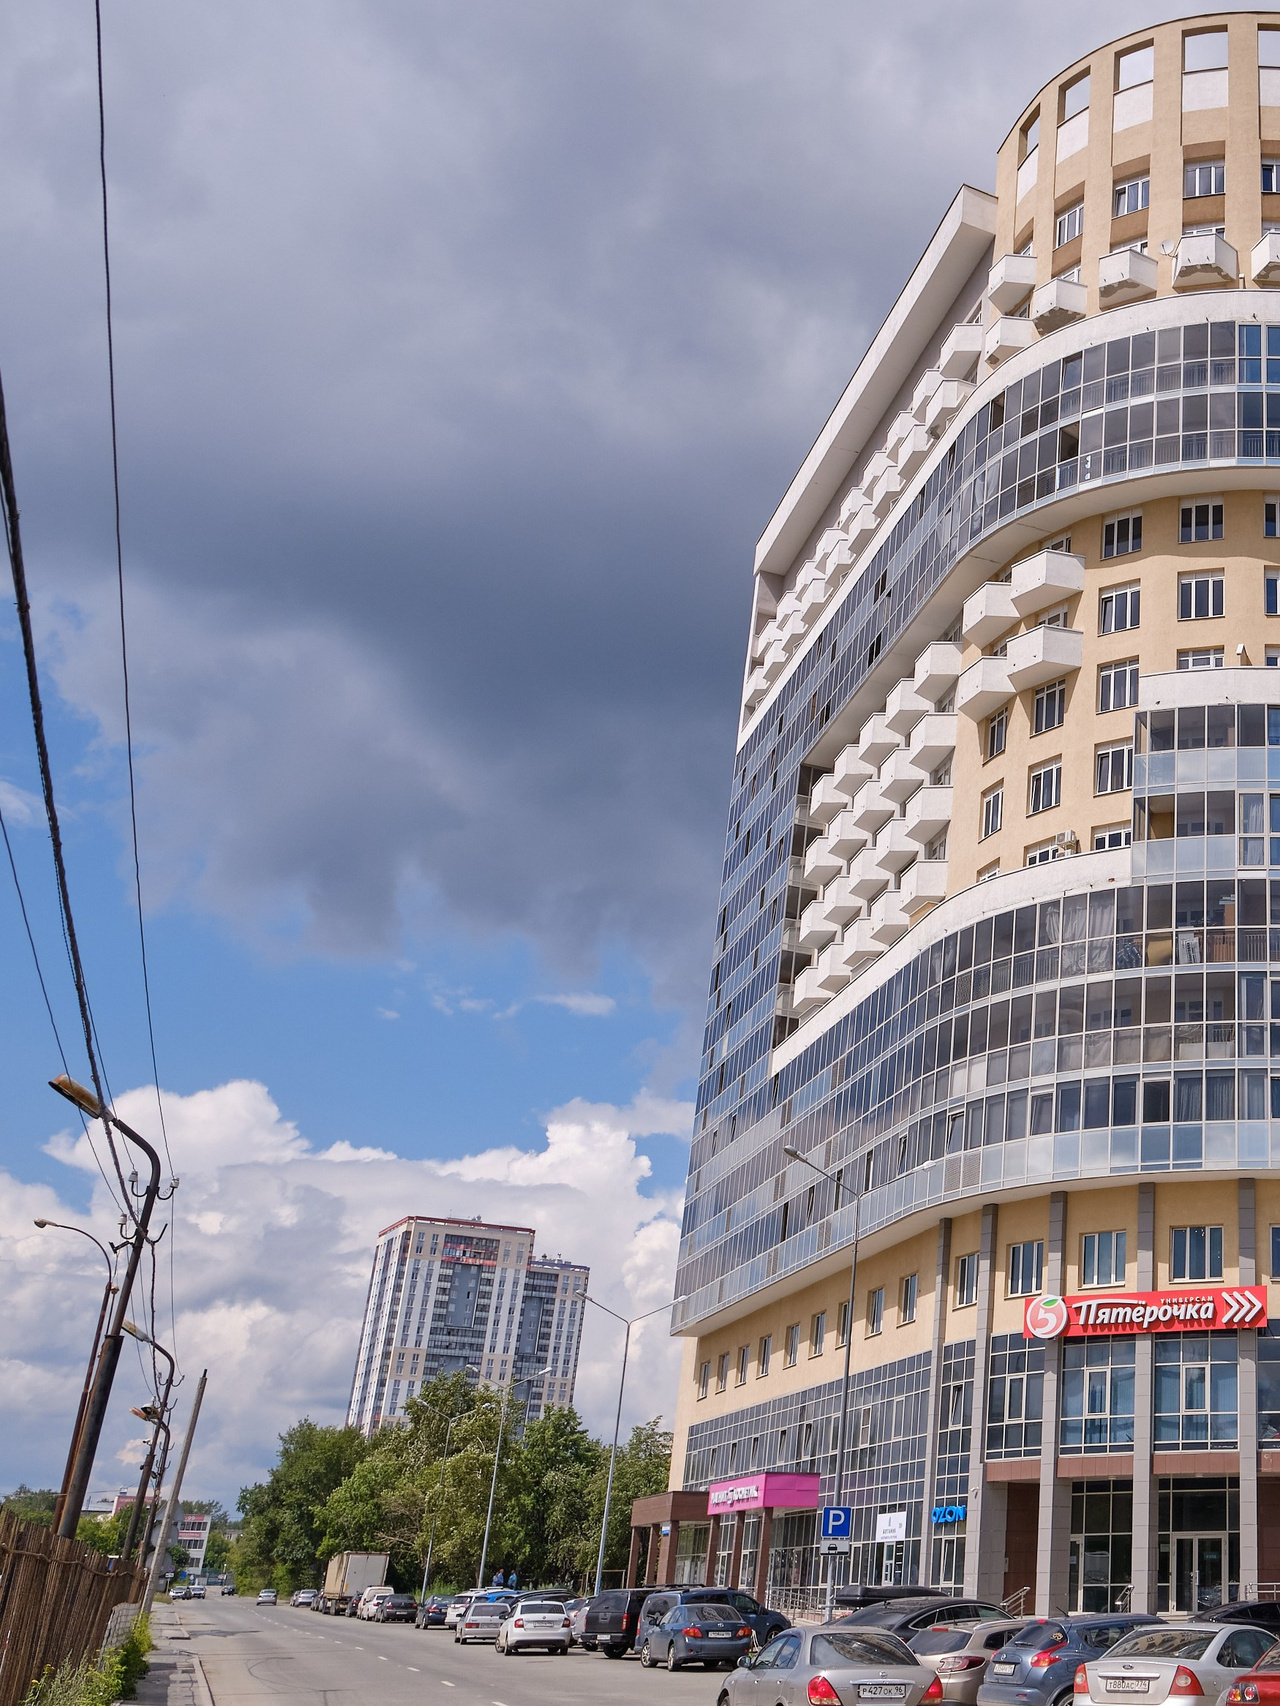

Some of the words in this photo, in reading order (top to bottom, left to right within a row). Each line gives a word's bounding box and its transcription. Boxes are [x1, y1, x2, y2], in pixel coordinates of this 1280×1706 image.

[1160, 1296, 1214, 1304] УНИВЕРСАМ
[828, 1510, 845, 1534] P
[931, 1505, 966, 1524] OZON
